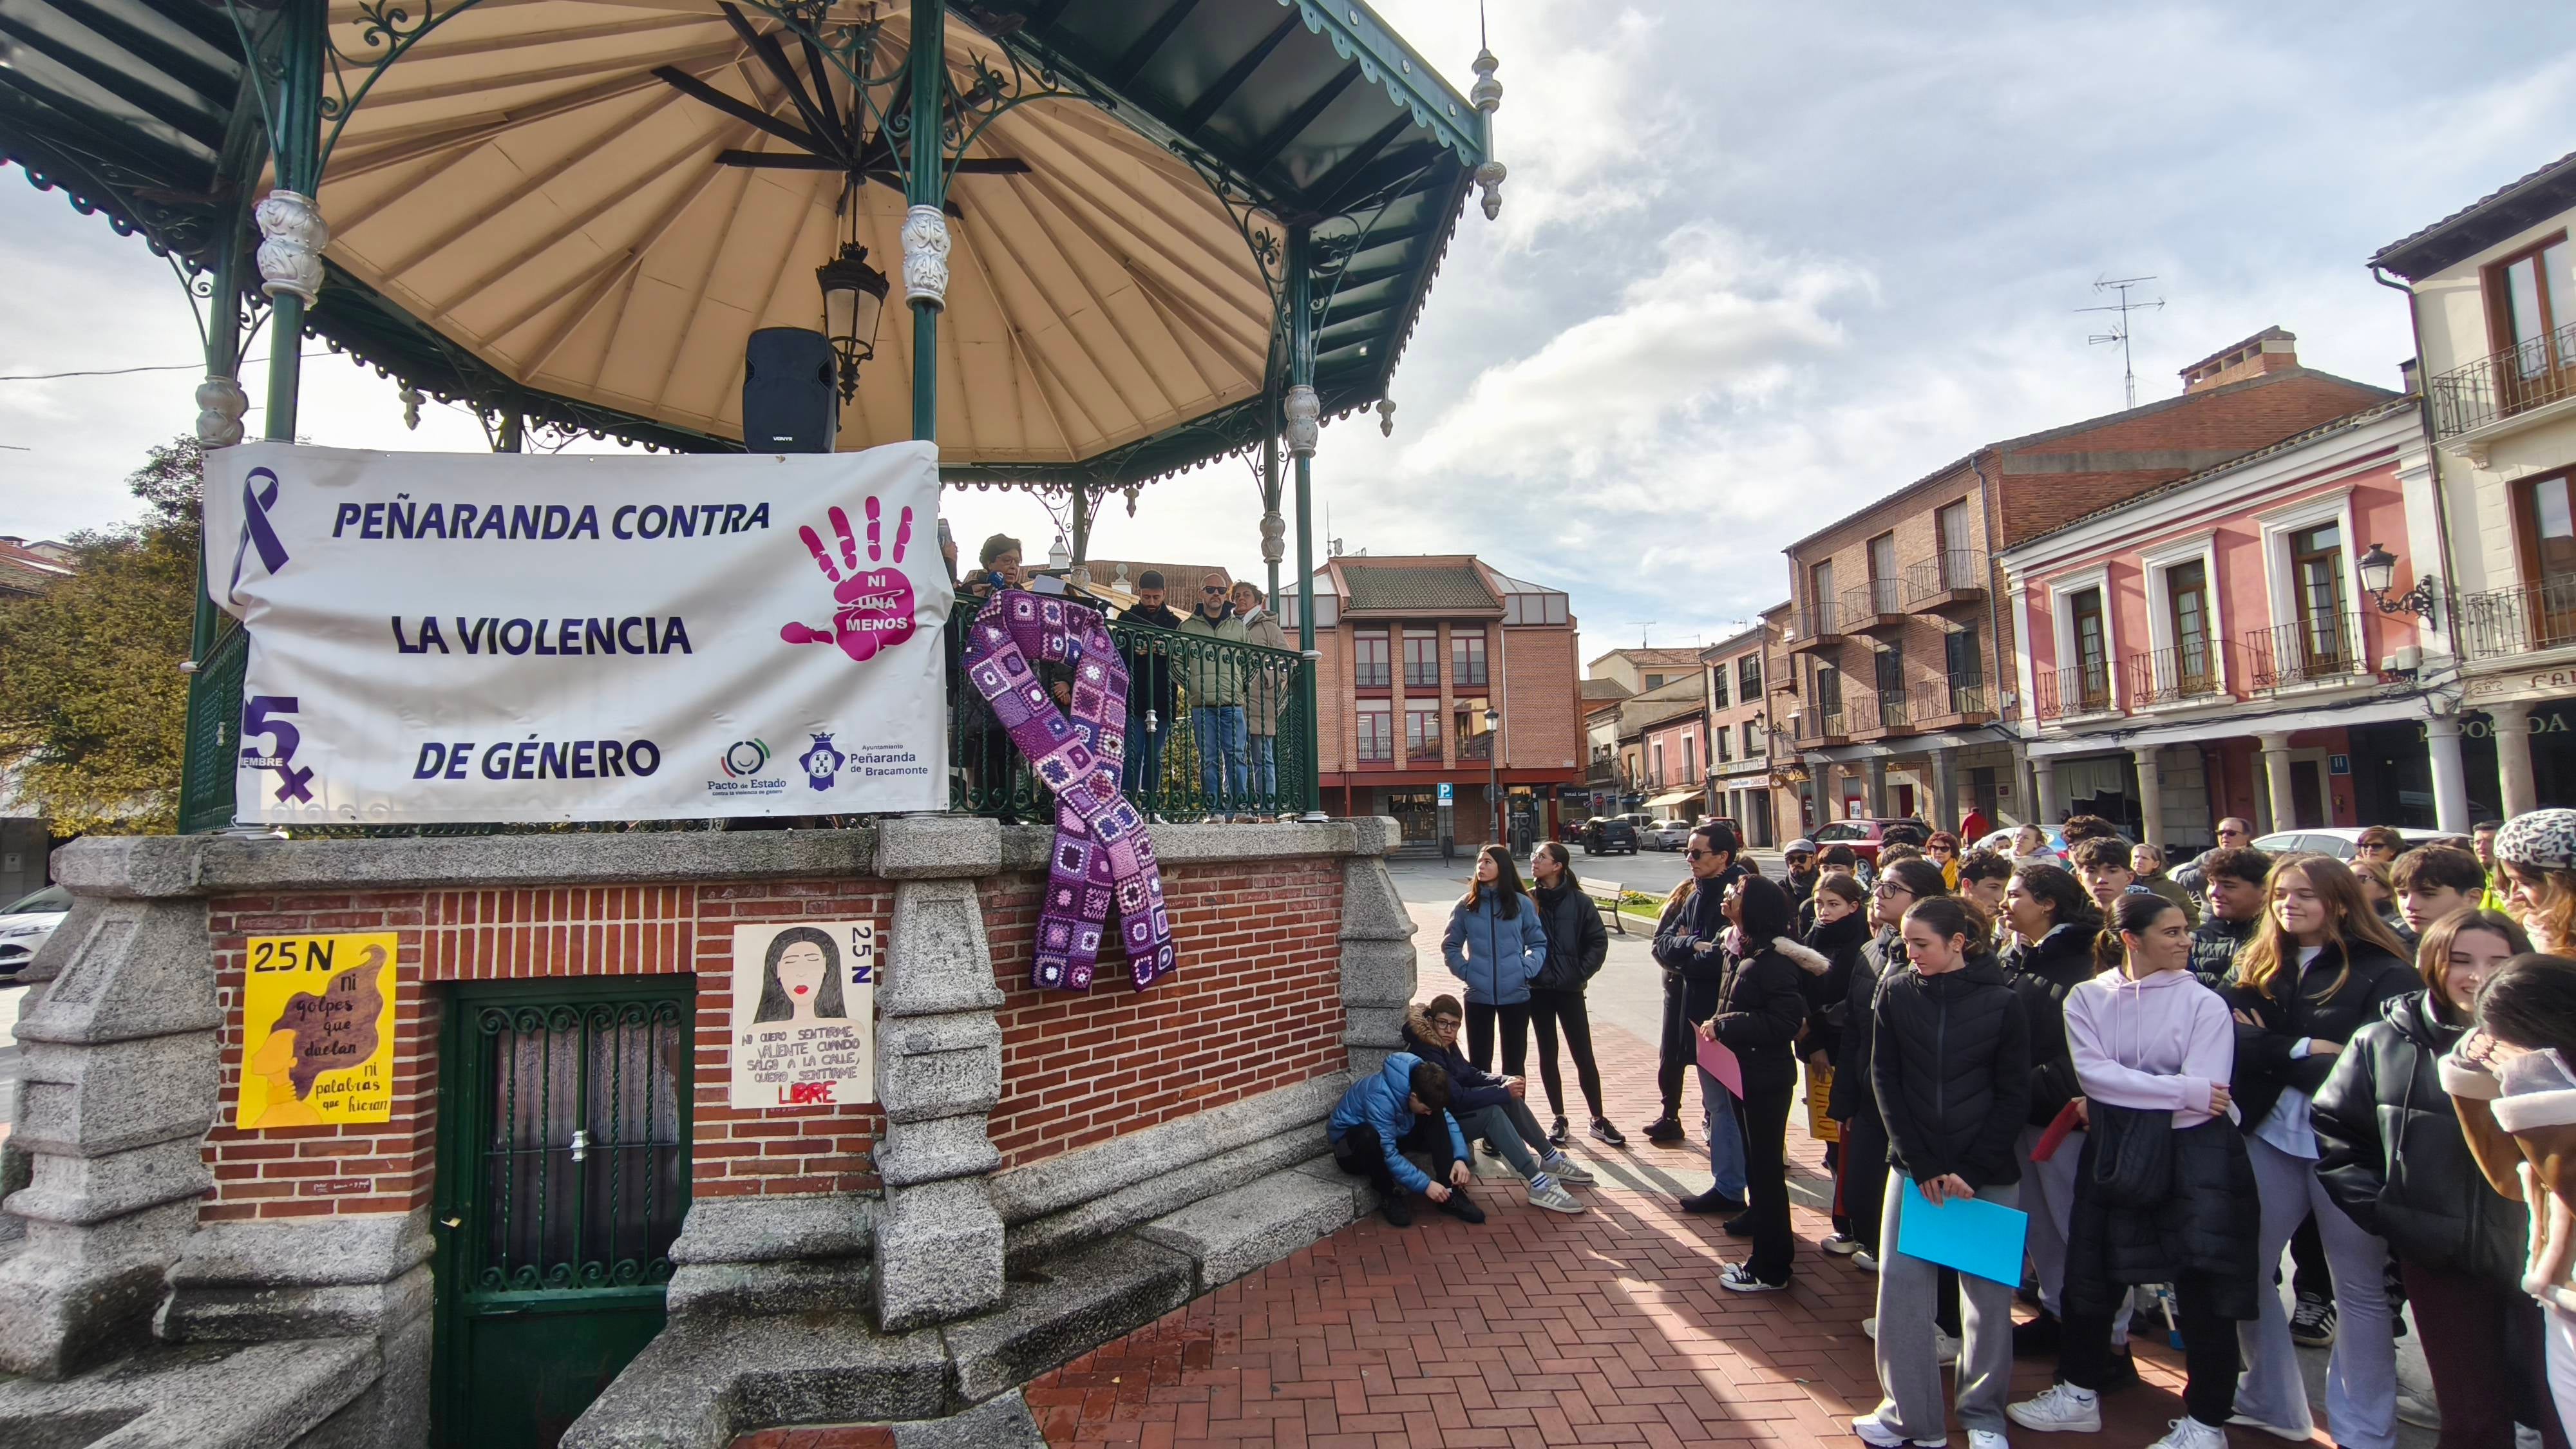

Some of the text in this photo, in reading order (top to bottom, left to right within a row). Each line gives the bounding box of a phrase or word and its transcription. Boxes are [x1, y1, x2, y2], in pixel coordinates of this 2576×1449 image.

[332, 493, 770, 540] PEÑARANDA CONTRA
[867, 574, 886, 587] NI
[858, 596, 897, 610] UNA
[846, 617, 908, 632] MENOS
[392, 616, 692, 656] LA VIOLENCIA
[413, 734, 661, 779] DE GÉNERO
[850, 752, 916, 764] Peñaranda
[866, 766, 928, 776] Bracamonte
[708, 781, 738, 790] Pacto
[750, 779, 786, 789] Estado
[1440, 784, 1450, 797] P
[254, 939, 334, 973] 25 N
[340, 973, 356, 992] ni
[296, 996, 353, 1021] golpes
[323, 1019, 351, 1036] que
[742, 1025, 854, 1046] NO QUIERO SENTIRME
[305, 1038, 356, 1057] duelan
[757, 1037, 860, 1059] VALIENTE CUANDO
[365, 1062, 377, 1077] ni
[747, 1058, 779, 1071] SALGO
[787, 1059, 796, 1069] A
[803, 1055, 816, 1067] LA
[754, 1066, 858, 1083] QUIERO SENTIRME
[316, 1077, 380, 1099] palabras
[778, 1081, 837, 1104] LIBRE
[323, 1096, 388, 1113] que hieran
